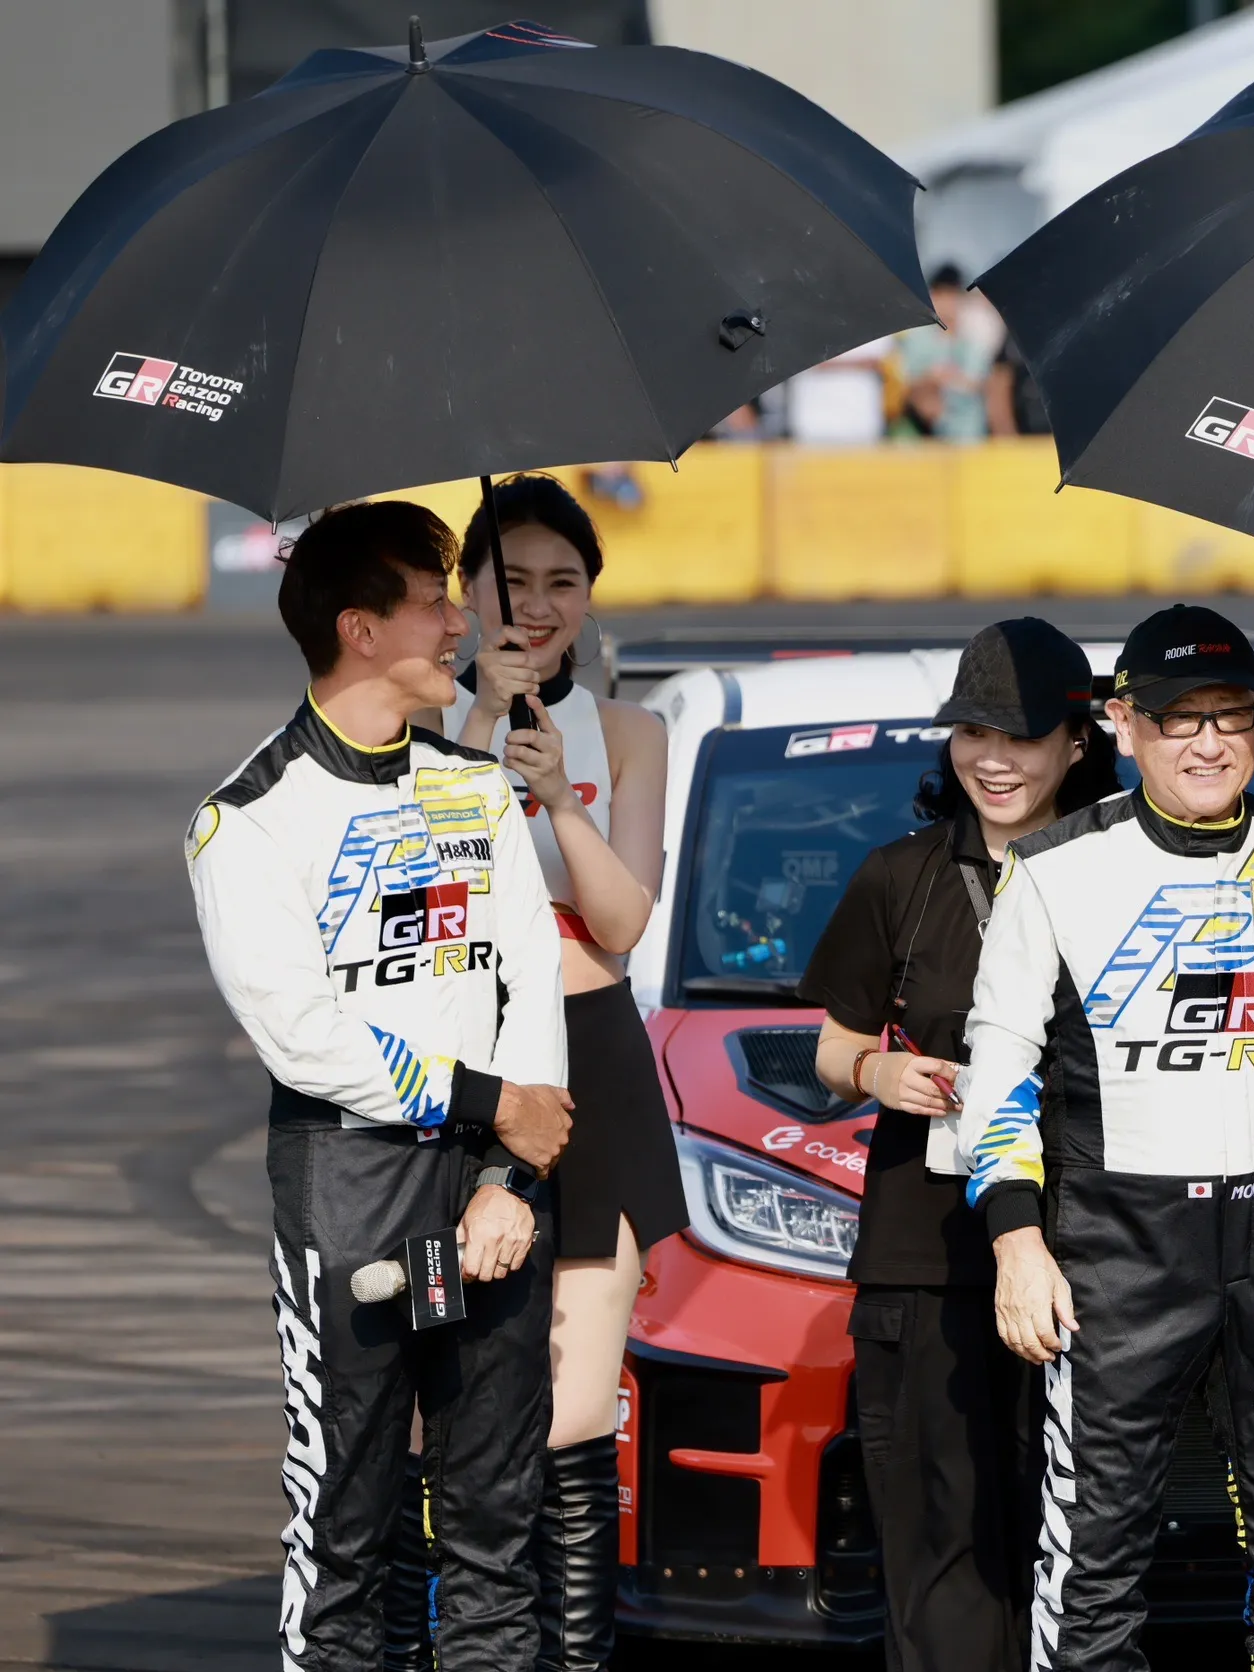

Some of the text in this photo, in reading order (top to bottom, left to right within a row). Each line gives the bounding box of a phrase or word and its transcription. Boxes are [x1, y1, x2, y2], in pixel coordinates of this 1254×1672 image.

[100, 370, 163, 403] GR
[169, 381, 231, 406] GAZOO
[179, 366, 243, 394] TOYOTA
[162, 393, 223, 422] Racing
[1165, 644, 1196, 660] ROOKIE
[789, 732, 872, 756] GR
[432, 810, 478, 820] RAVENOL
[382, 904, 466, 948] GR
[333, 941, 493, 993] TG-RR
[426, 1240, 436, 1286] GAZOO
[433, 1240, 443, 1286] Racing
[434, 1288, 446, 1316] GR
